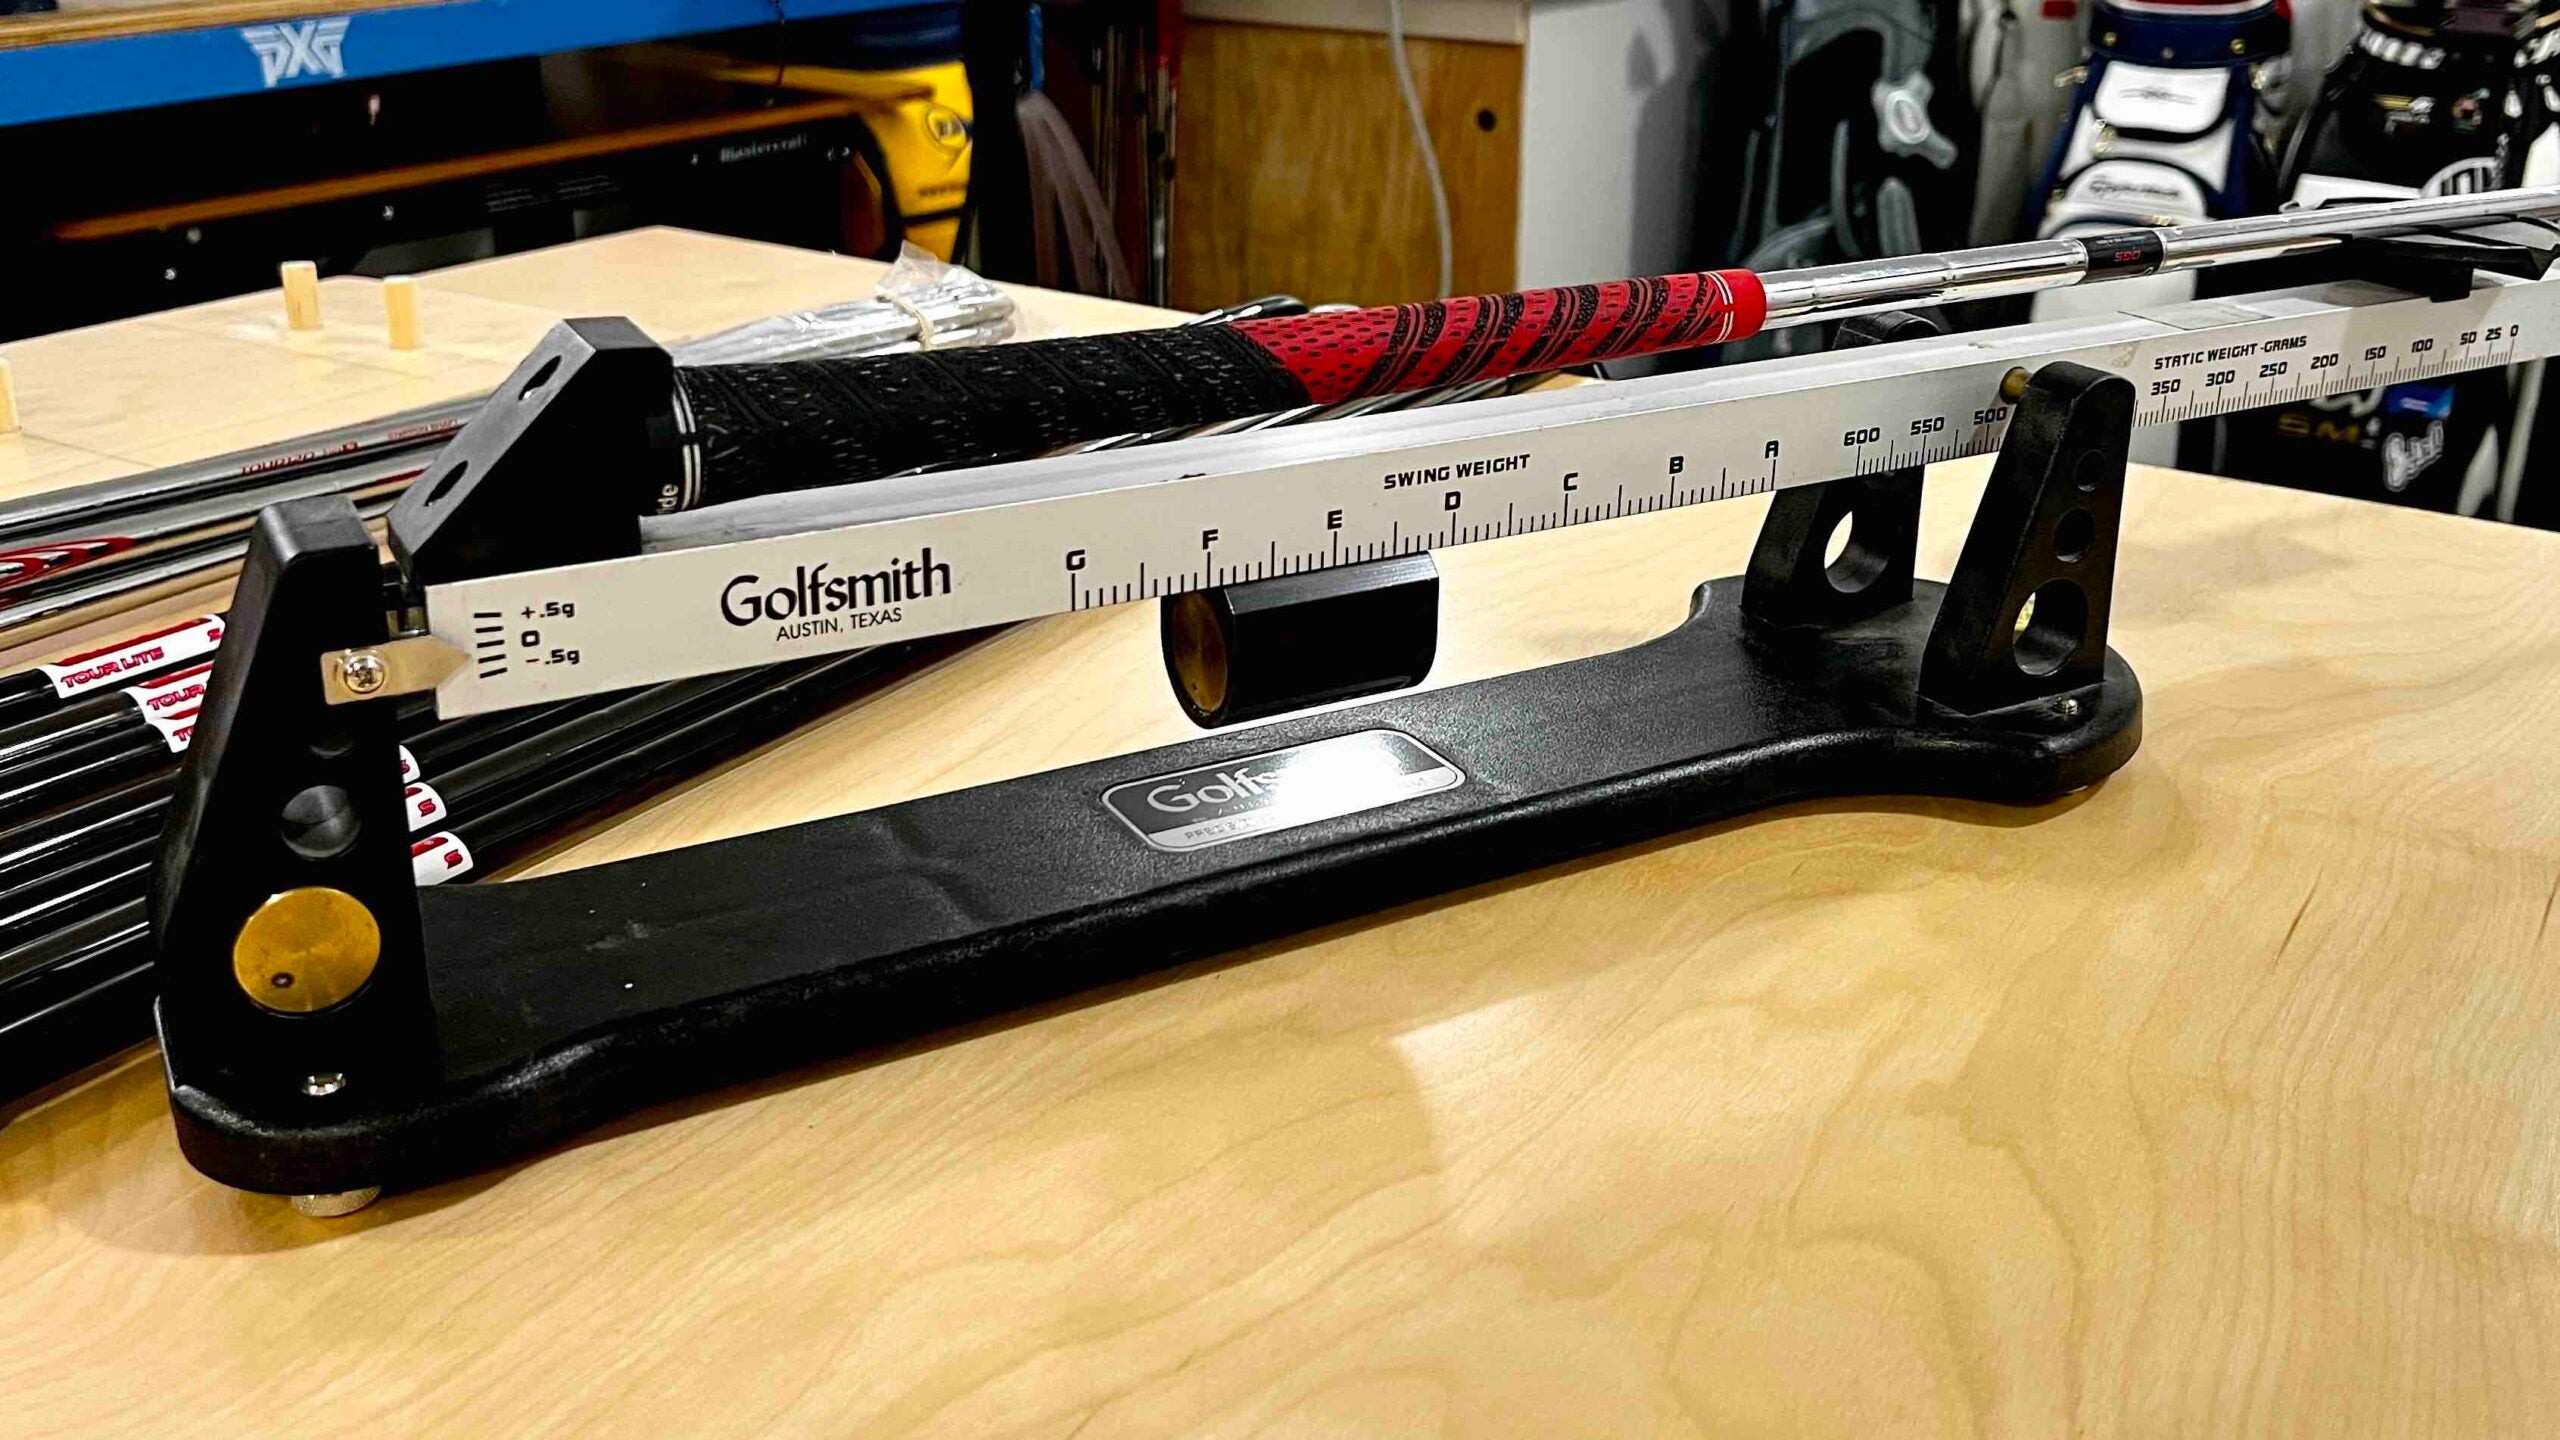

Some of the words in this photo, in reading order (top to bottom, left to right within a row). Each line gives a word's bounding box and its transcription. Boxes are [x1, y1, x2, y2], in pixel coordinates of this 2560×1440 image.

[2154, 351, 2204, 370] STATIC
[2207, 343, 2258, 362] WEIGHT
[1843, 427, 1880, 446] 600
[1910, 416, 1945, 436] 550
[1973, 406, 2007, 425] 500
[2151, 379, 2181, 396] 350
[2205, 370, 2235, 387] 300
[2259, 361, 2288, 378] 250
[2310, 353, 2339, 370] 200
[2364, 346, 2387, 361] 150
[2411, 338, 2434, 353] 100
[2460, 331, 2477, 345] 50
[2485, 327, 2502, 341] 25
[2510, 324, 2519, 337] 0
[1384, 466, 1450, 490] SWING
[1456, 453, 1530, 478] WEIGHT
[1066, 549, 1086, 571] G
[1202, 528, 1219, 550] F
[1327, 509, 1343, 530] E
[1444, 491, 1461, 511] D
[1563, 472, 1579, 492] C
[1669, 455, 1684, 475] B
[1764, 440, 1780, 459] A
[720, 547, 951, 626] Golfsmith
[521, 630, 540, 647] 0
[776, 617, 844, 641] AUSTIN,
[850, 607, 902, 630] TEXAS
[61, 661, 121, 688] TOUR
[120, 646, 165, 671] LITE
[147, 684, 205, 711] TOUR
[418, 798, 436, 817] S
[444, 848, 463, 869] S
